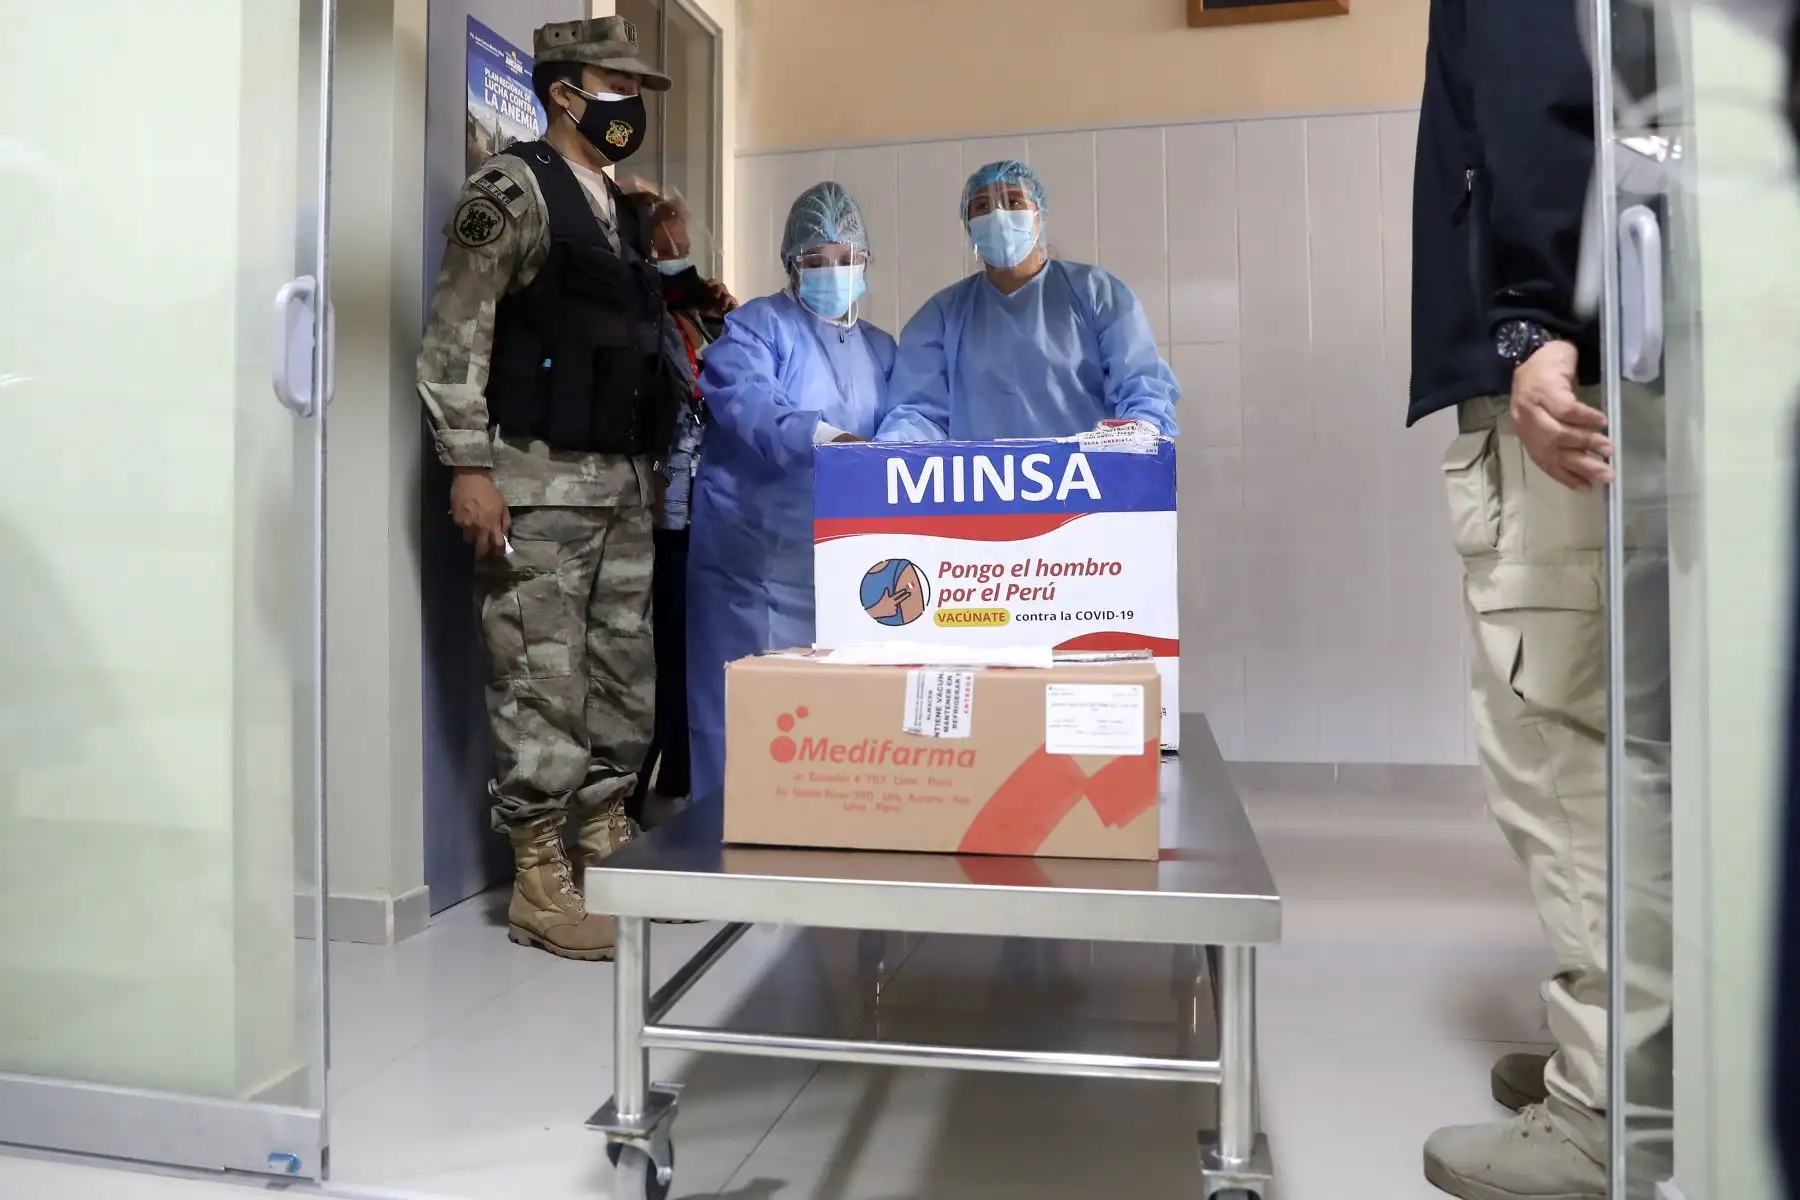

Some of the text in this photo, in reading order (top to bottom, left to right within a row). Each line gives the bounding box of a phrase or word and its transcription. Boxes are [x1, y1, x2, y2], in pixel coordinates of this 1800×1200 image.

[484, 67, 499, 82] PLAN
[499, 75, 525, 98] REGIONAL
[525, 91, 532, 103] DE
[484, 77, 509, 99] LUCHA
[509, 90, 536, 117] CONTRA
[484, 88, 539, 133] LA ANEMIA
[886, 453, 1102, 505] MINSA
[938, 558, 1122, 583] Pongo el hombro
[937, 582, 1056, 608] por el Perú
[937, 609, 1134, 623] VACÚNATE contra la COVID-19
[943, 675, 953, 732] MANTENER EN
[952, 679, 961, 729] REFRIGERAR
[798, 736, 977, 769] Medifarma
